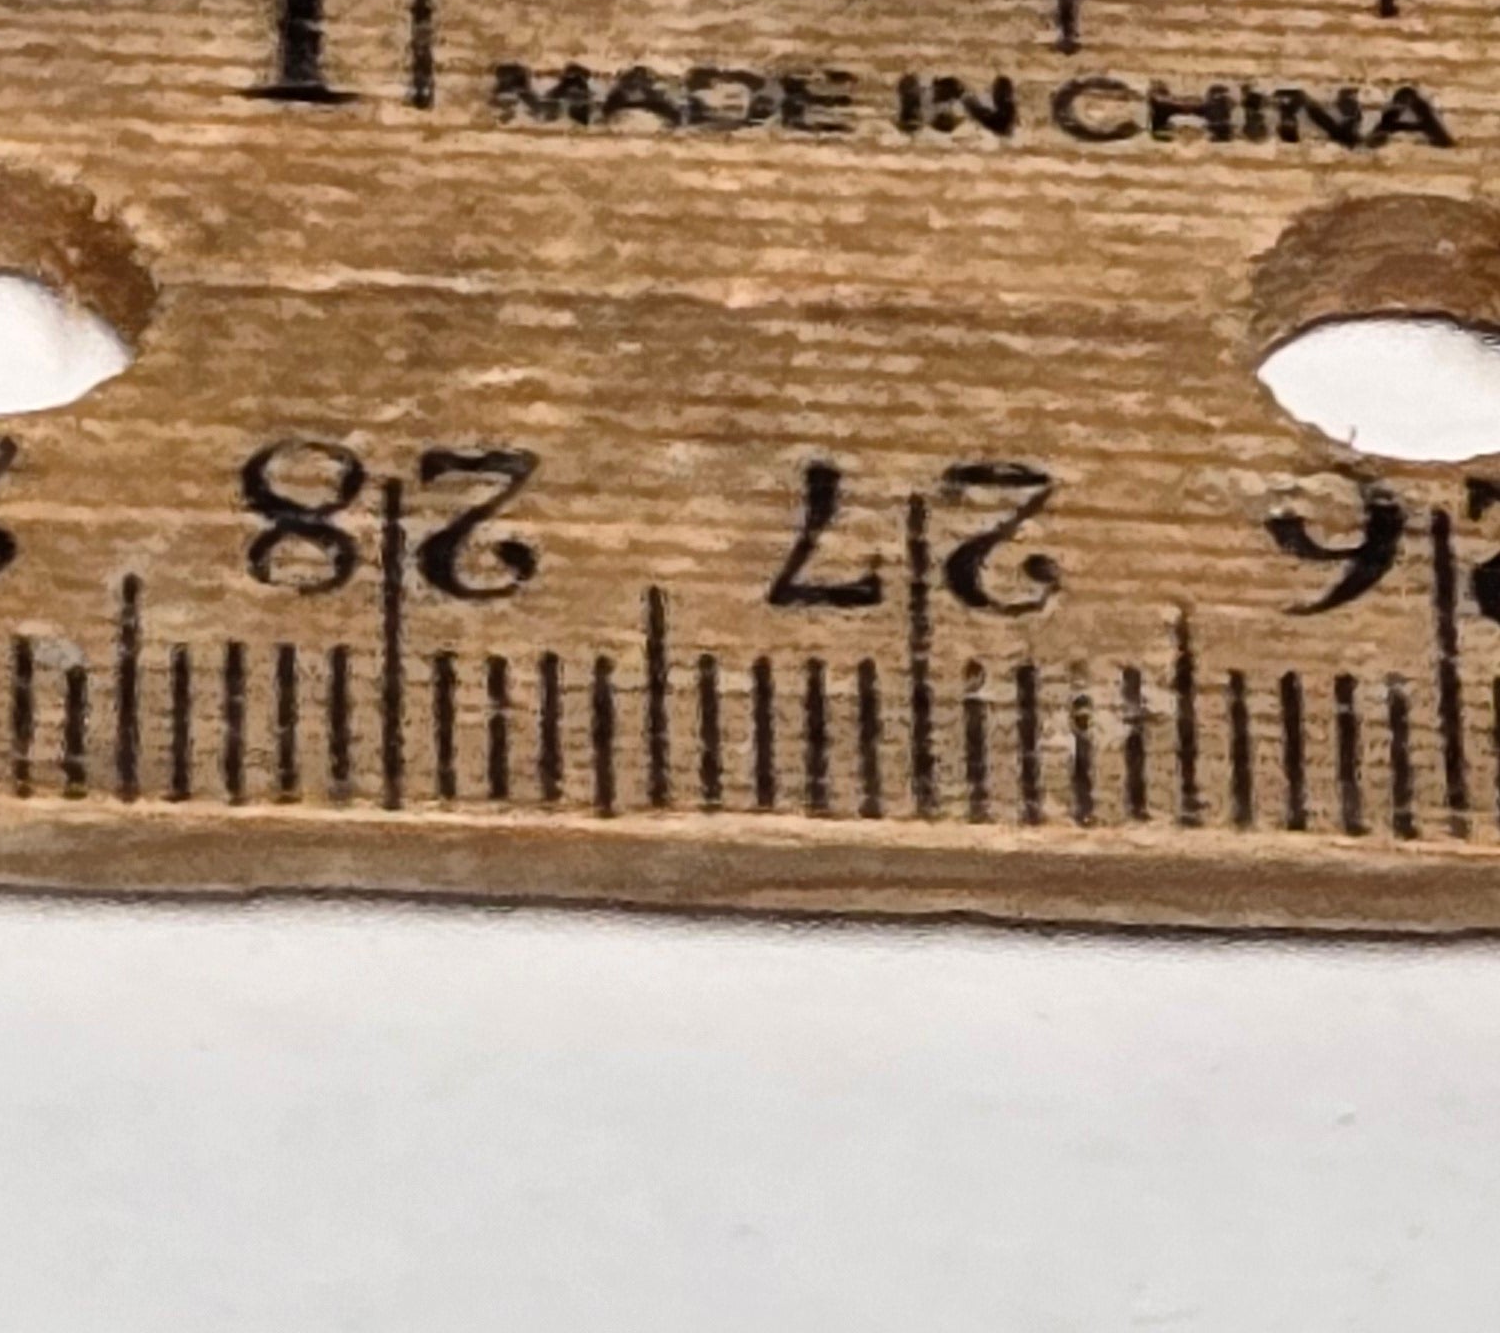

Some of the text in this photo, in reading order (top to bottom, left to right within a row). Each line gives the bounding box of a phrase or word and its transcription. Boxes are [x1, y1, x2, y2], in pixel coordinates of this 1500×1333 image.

[498, 62, 1456, 149] MADE IN CHINA
